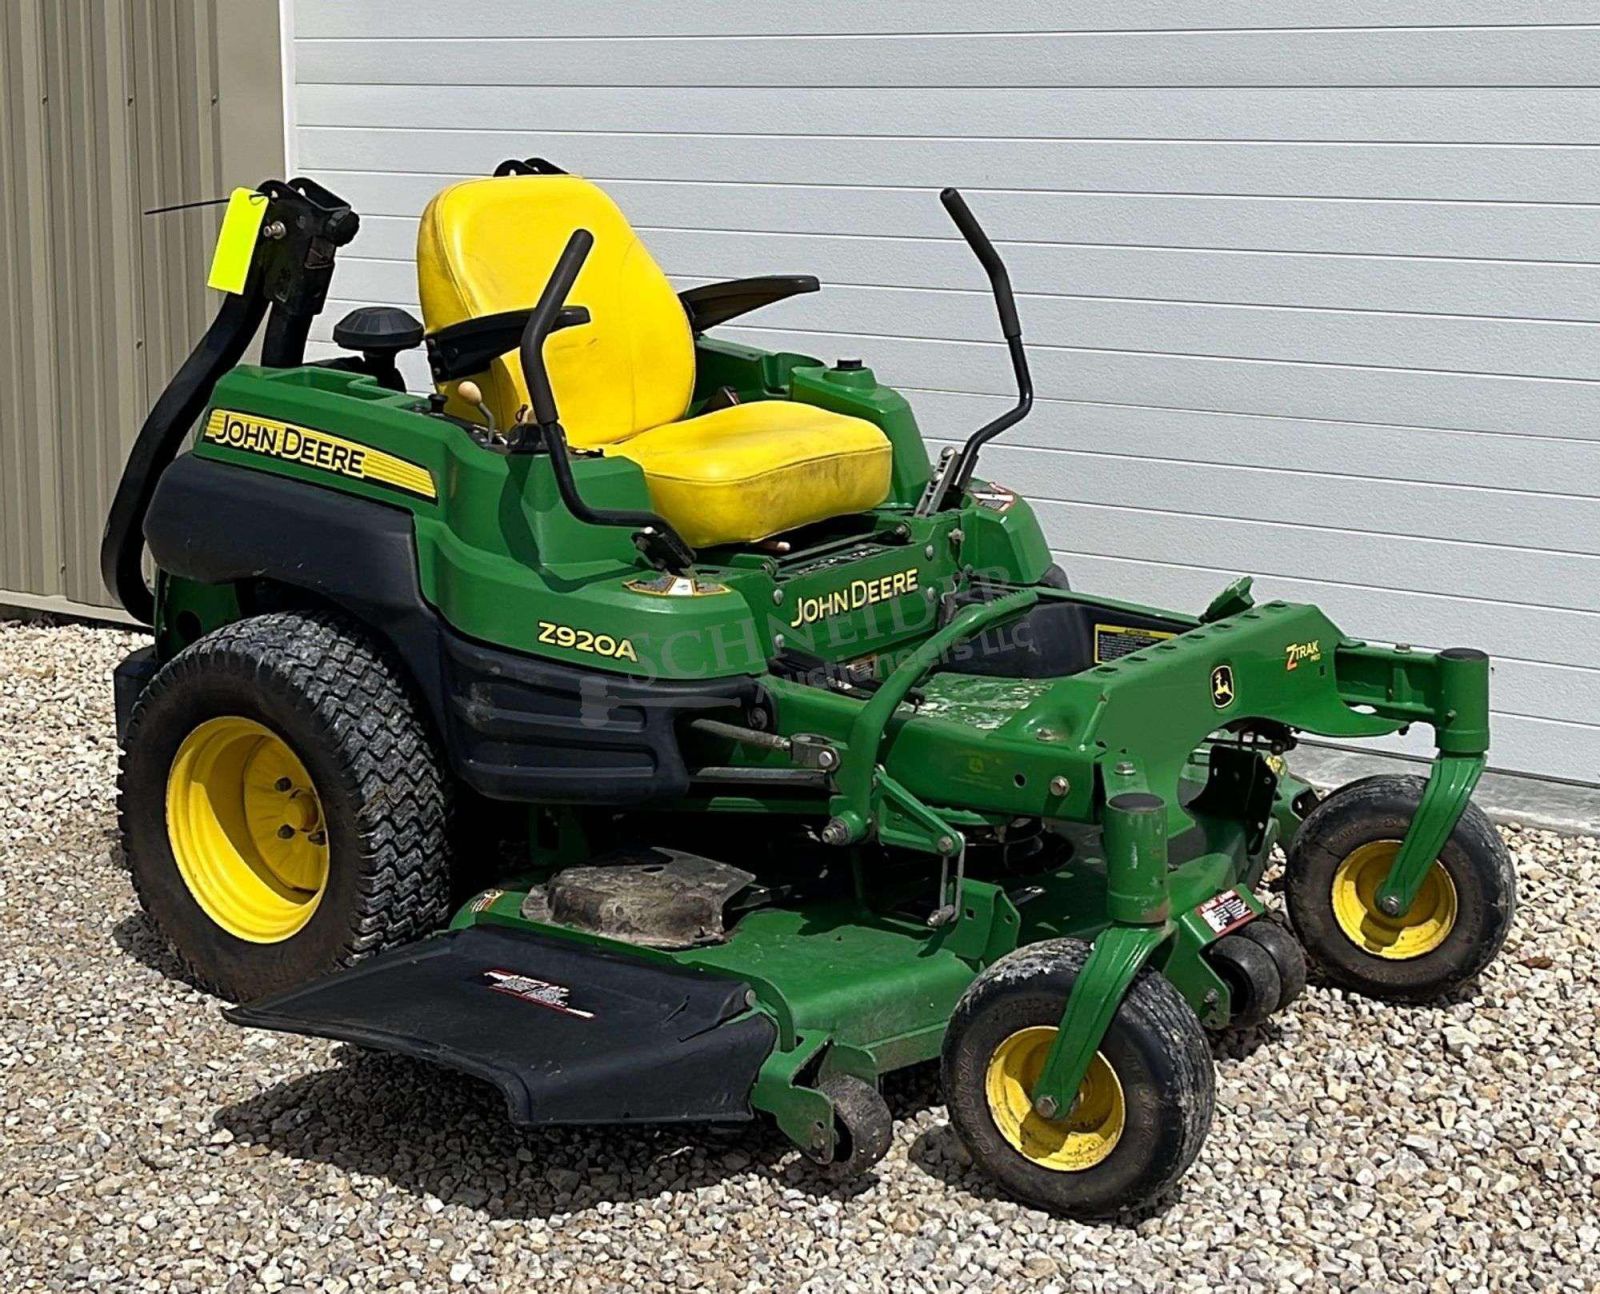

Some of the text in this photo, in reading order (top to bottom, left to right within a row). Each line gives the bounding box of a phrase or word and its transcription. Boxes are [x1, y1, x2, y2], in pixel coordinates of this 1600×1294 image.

[215, 414, 366, 476] JOHN DEERE
[790, 568, 919, 628] JOHN DEERE
[537, 621, 639, 663] Z920A
